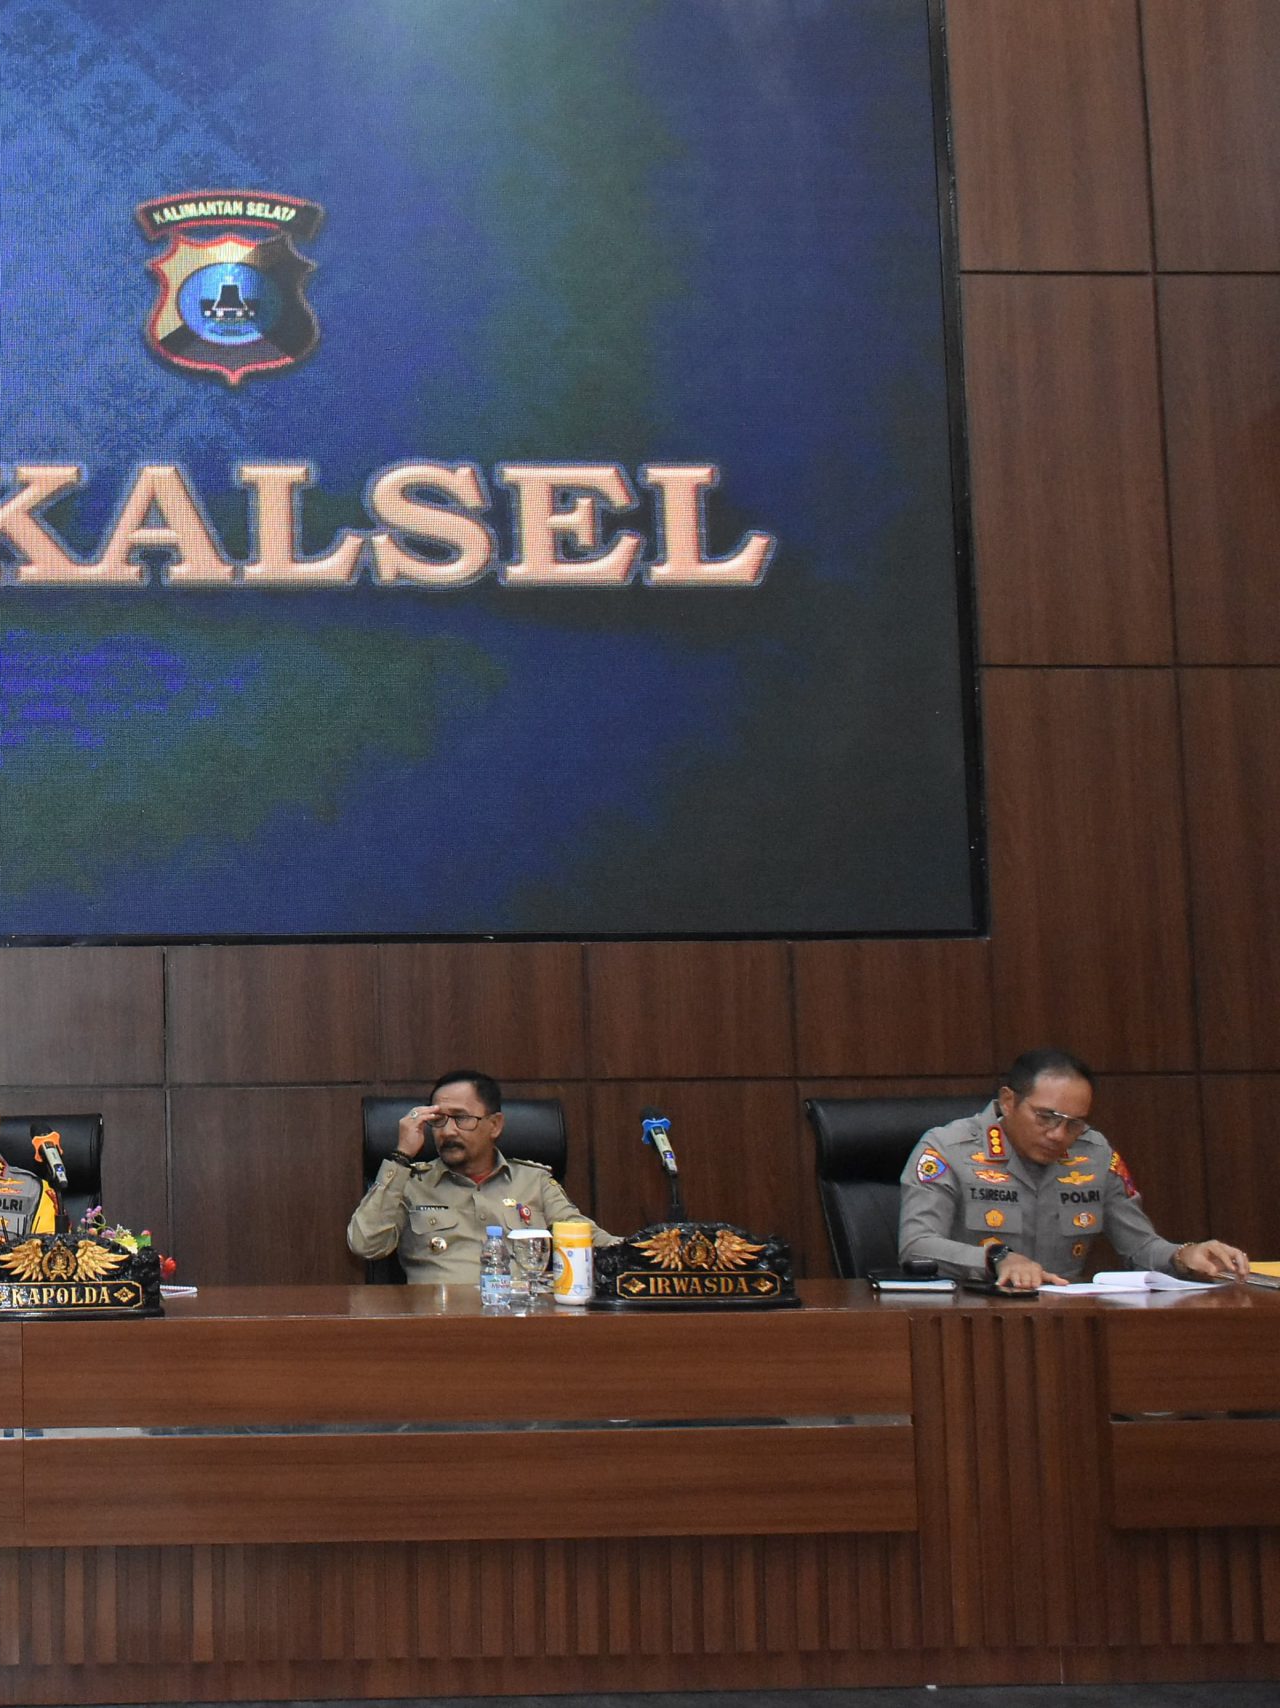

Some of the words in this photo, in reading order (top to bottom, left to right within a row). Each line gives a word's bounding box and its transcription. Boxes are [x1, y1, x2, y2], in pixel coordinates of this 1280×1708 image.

[153, 200, 243, 225] KALIMANTAN
[979, 1188, 1019, 1203] SIREGAR
[1060, 1190, 1100, 1204] POLRI
[648, 1276, 749, 1295] IRWASDA
[11, 1286, 111, 1306] KAPOLDA
